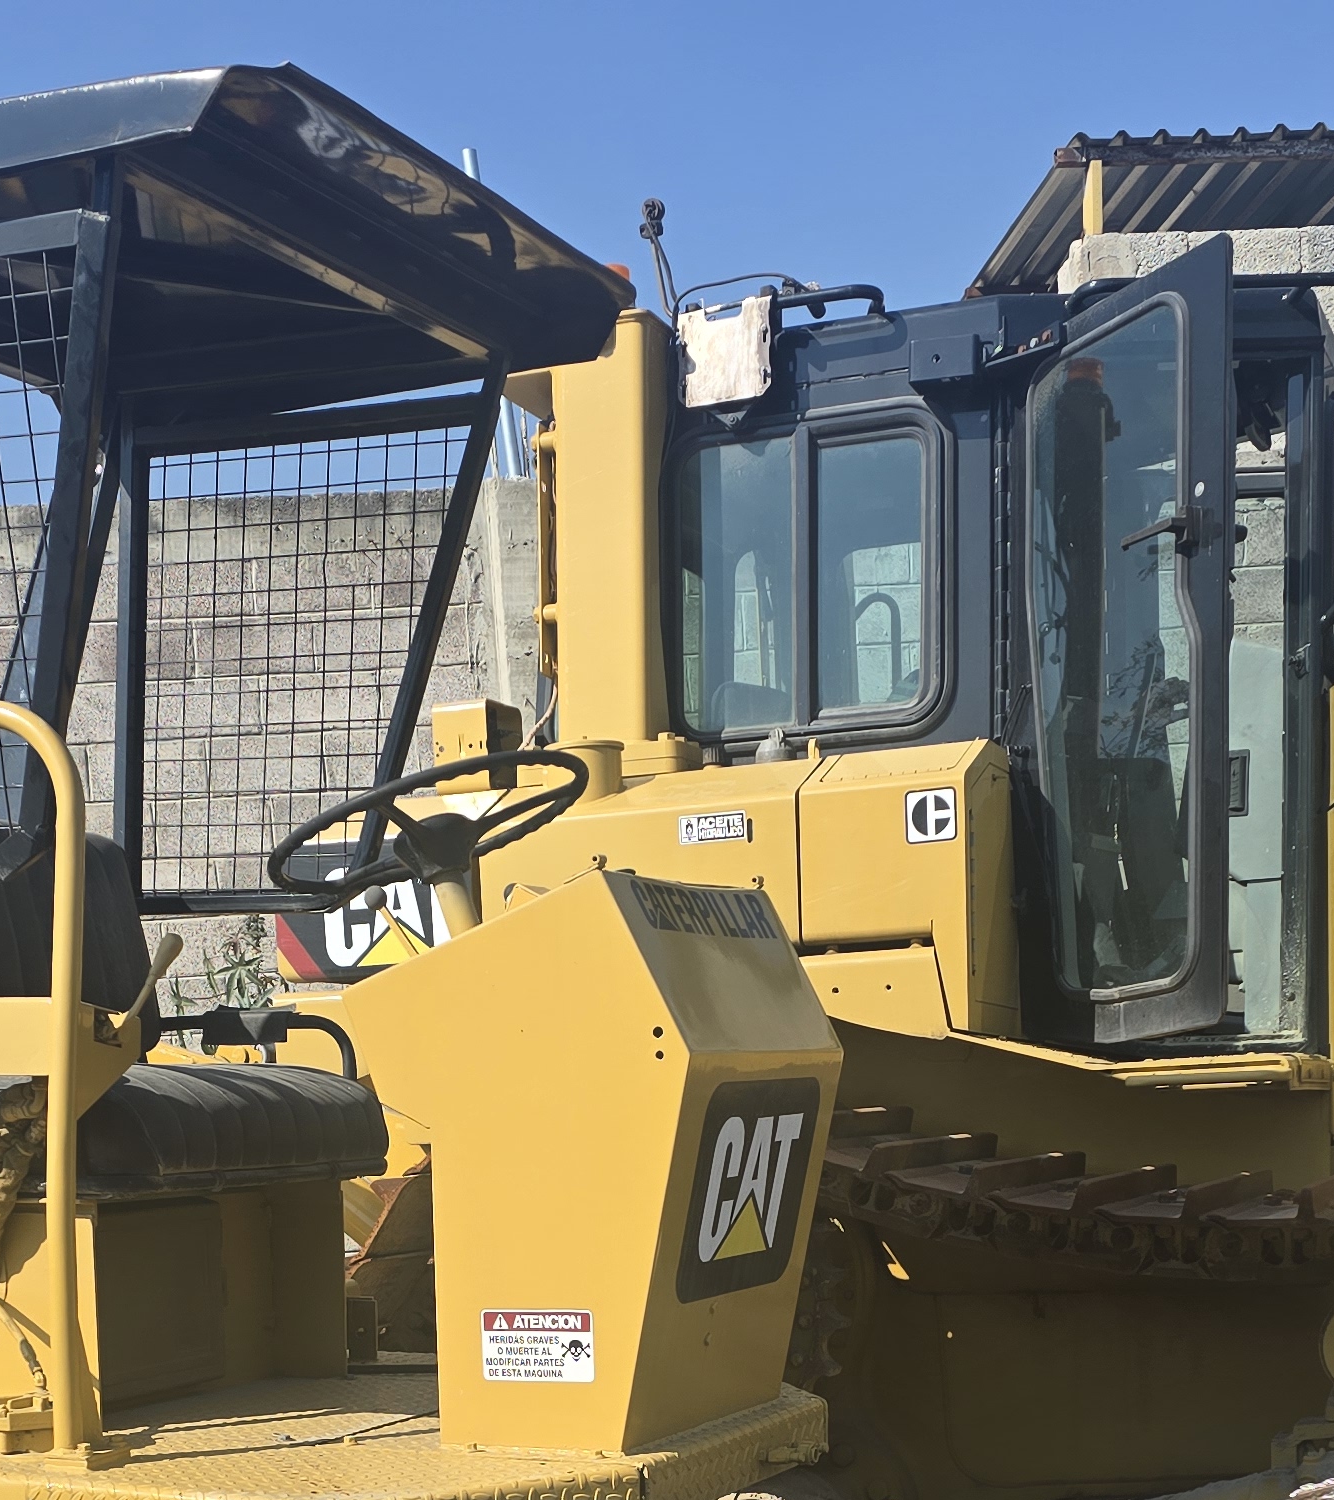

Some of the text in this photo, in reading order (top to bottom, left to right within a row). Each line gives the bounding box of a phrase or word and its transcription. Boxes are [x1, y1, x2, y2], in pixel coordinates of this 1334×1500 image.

[698, 814, 743, 829] ACEITE
[630, 879, 778, 939] CATERPILLAR
[698, 1113, 804, 1263] CAT
[512, 1314, 582, 1330] ATENCION
[526, 1335, 560, 1345] GRAVES
[497, 1346, 553, 1356] O MUERTE AL
[485, 1357, 565, 1367] MODIFICAR PARTES
[488, 1368, 564, 1378] DE ESTA MAQUINA
